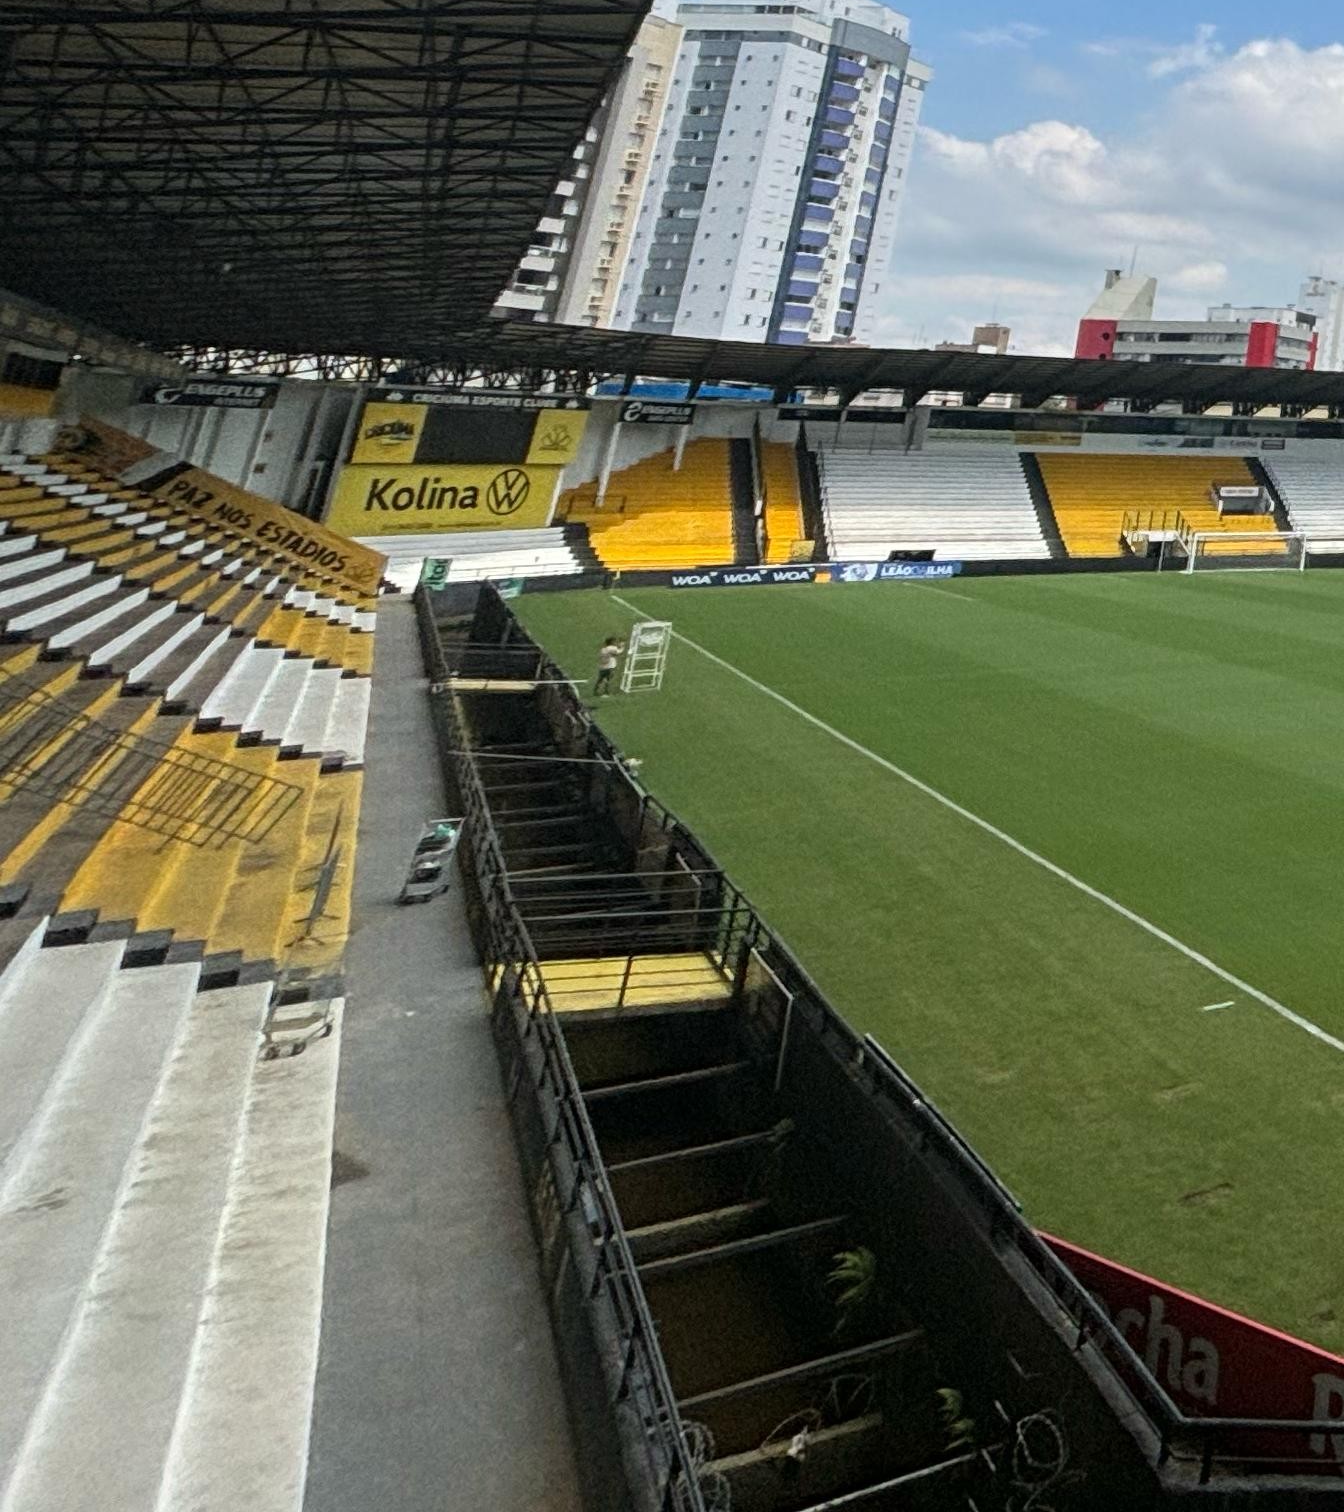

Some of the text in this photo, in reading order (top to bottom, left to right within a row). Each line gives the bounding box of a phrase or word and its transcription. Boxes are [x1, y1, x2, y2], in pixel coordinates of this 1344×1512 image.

[167, 480, 213, 509] PAZ
[213, 502, 254, 530] NOS
[365, 477, 478, 512] Kolina
[672, 571, 811, 586] WOA WOA WOA
